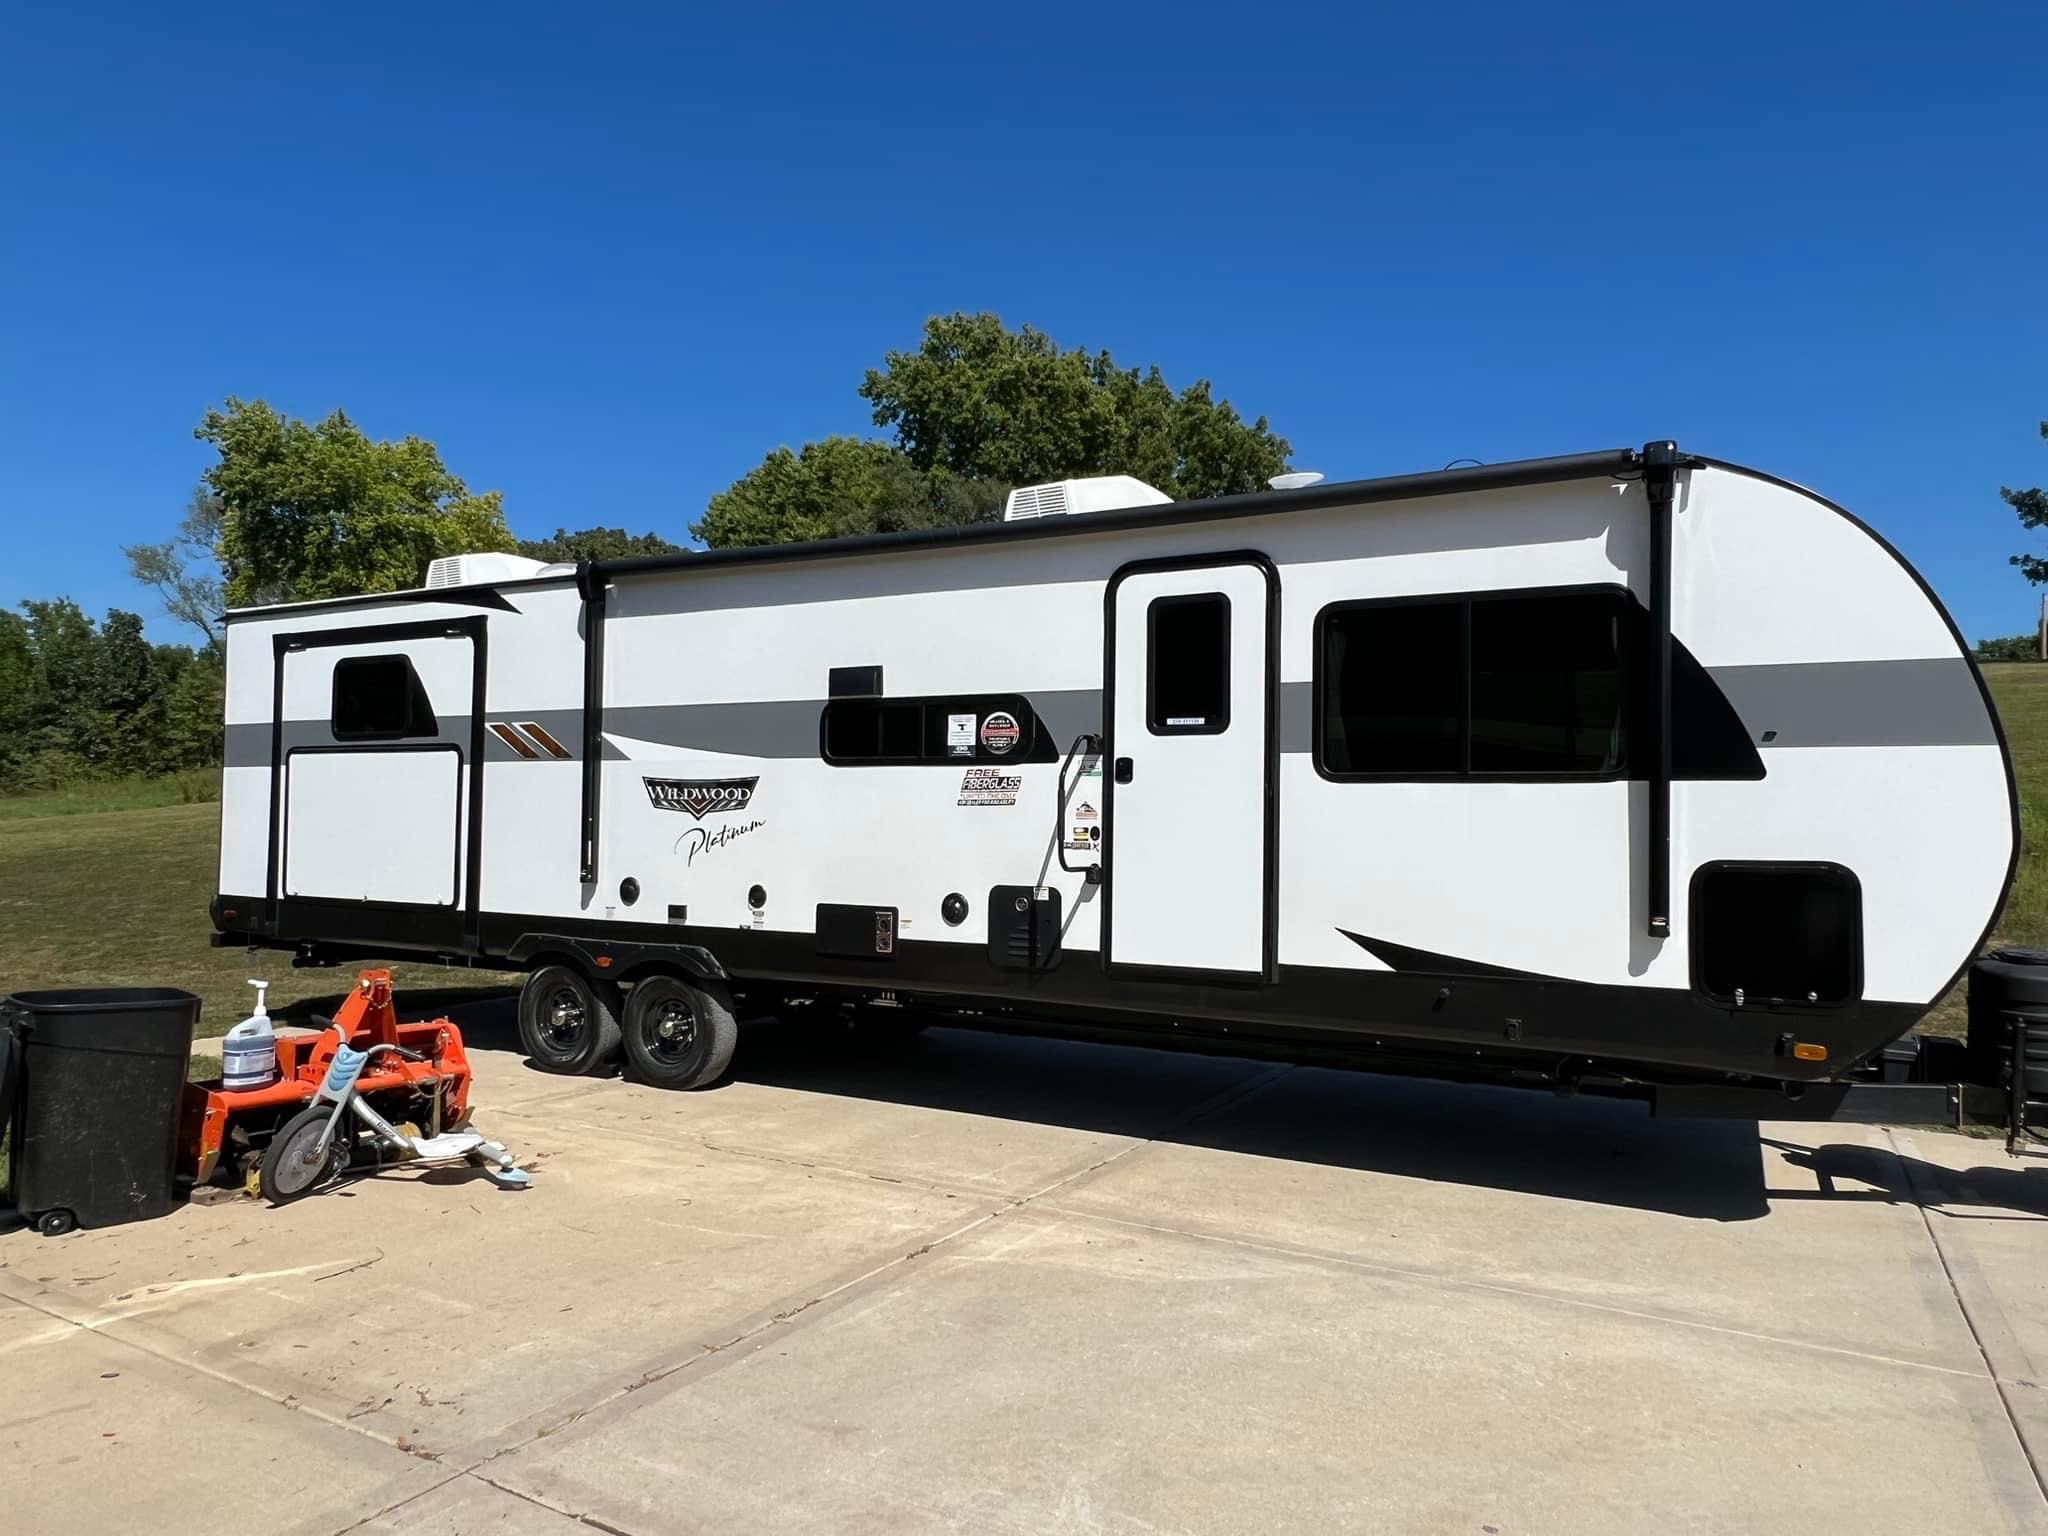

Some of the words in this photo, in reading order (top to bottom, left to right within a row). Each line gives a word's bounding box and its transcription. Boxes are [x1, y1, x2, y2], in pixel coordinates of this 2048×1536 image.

[965, 768, 1001, 777] FREE
[963, 777, 1021, 790] FIBERGLASS
[648, 785, 751, 800] WILDWOOD
[674, 819, 767, 868] Platinum
